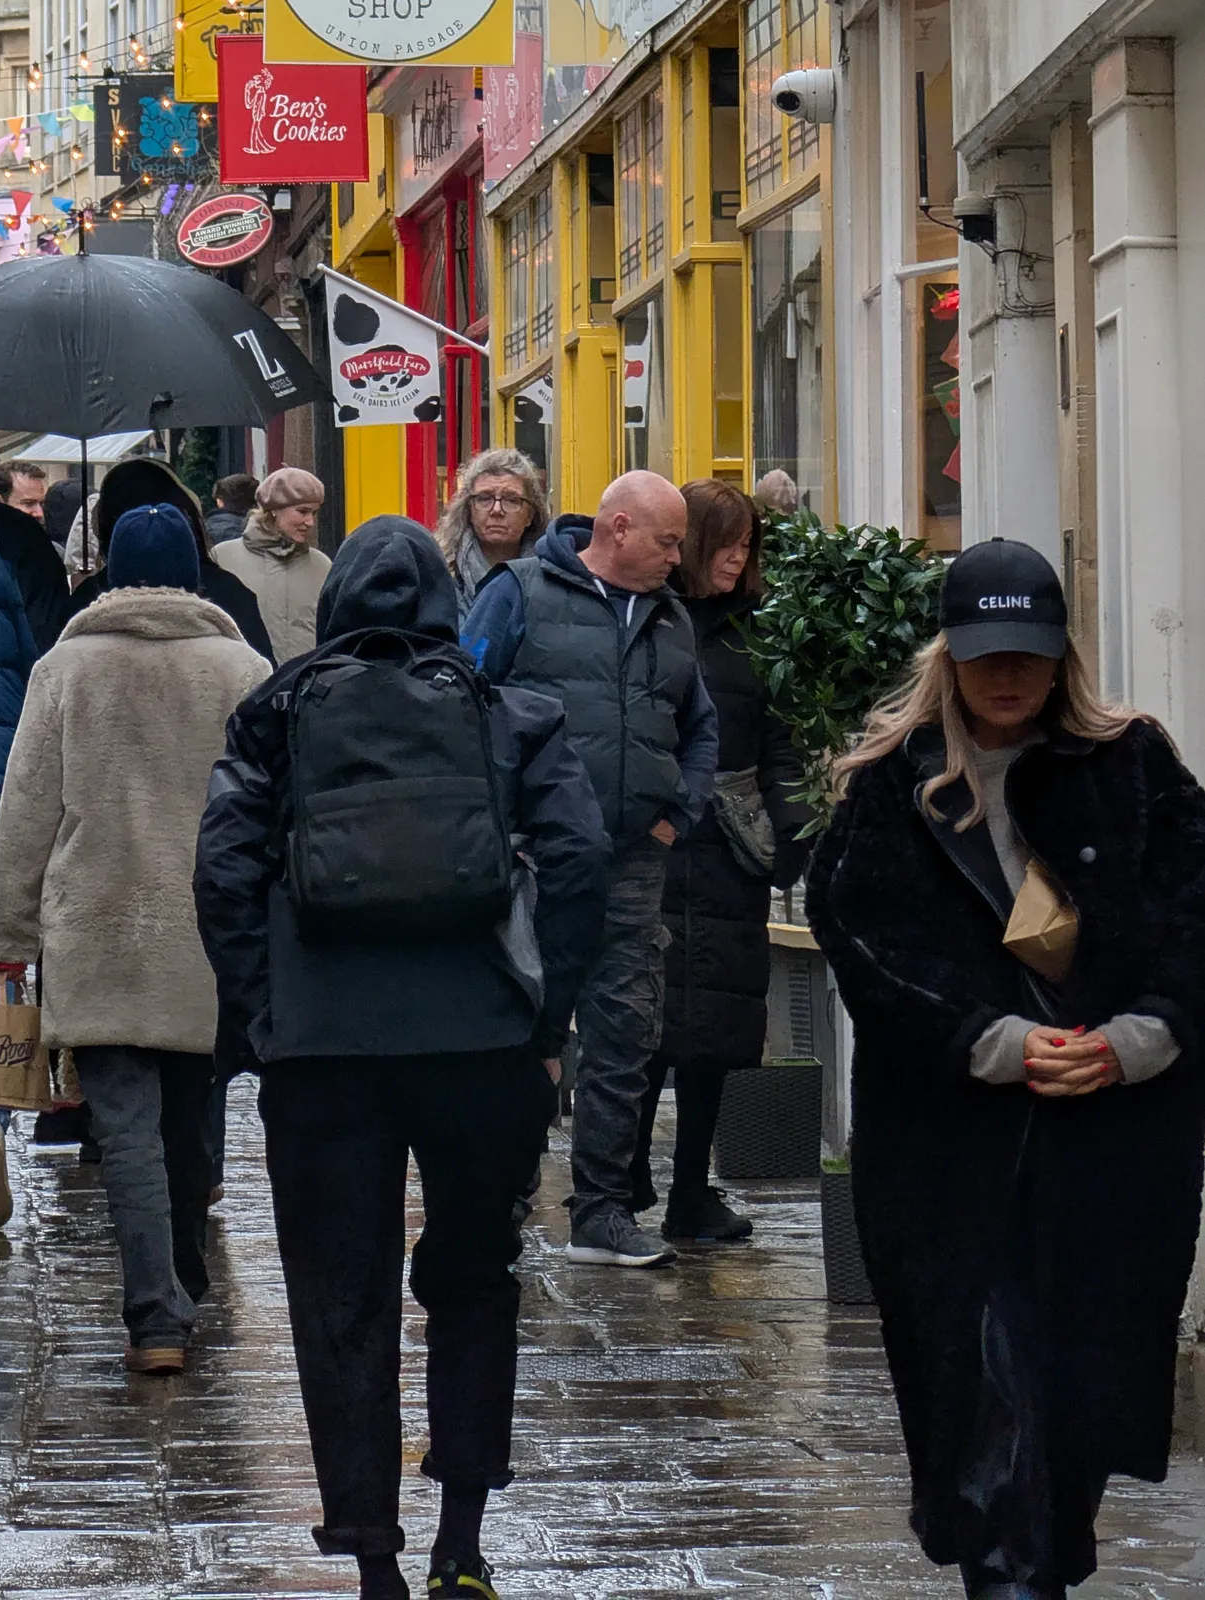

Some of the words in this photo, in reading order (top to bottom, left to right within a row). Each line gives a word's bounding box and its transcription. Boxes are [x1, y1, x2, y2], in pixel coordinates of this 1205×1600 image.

[325, 23, 381, 55] UNION
[395, 18, 464, 55] PASSAGE
[269, 94, 327, 119] Ben's
[272, 117, 347, 143] Cookies
[191, 199, 244, 224] CORNISH
[193, 231, 226, 243] CORNISH
[227, 223, 257, 236] PASTIES
[195, 226, 221, 237] AWARD
[222, 218, 255, 230] WINNING
[232, 329, 286, 381] Z
[345, 355, 402, 377] Marshfield
[403, 355, 427, 372] Farm
[268, 376, 293, 392] HOTELS
[352, 391, 367, 404] REAL
[368, 399, 388, 408] DAIRY
[390, 400, 401, 408] ICE
[402, 388, 420, 405] CREAM
[978, 595, 1032, 610] CELINE
